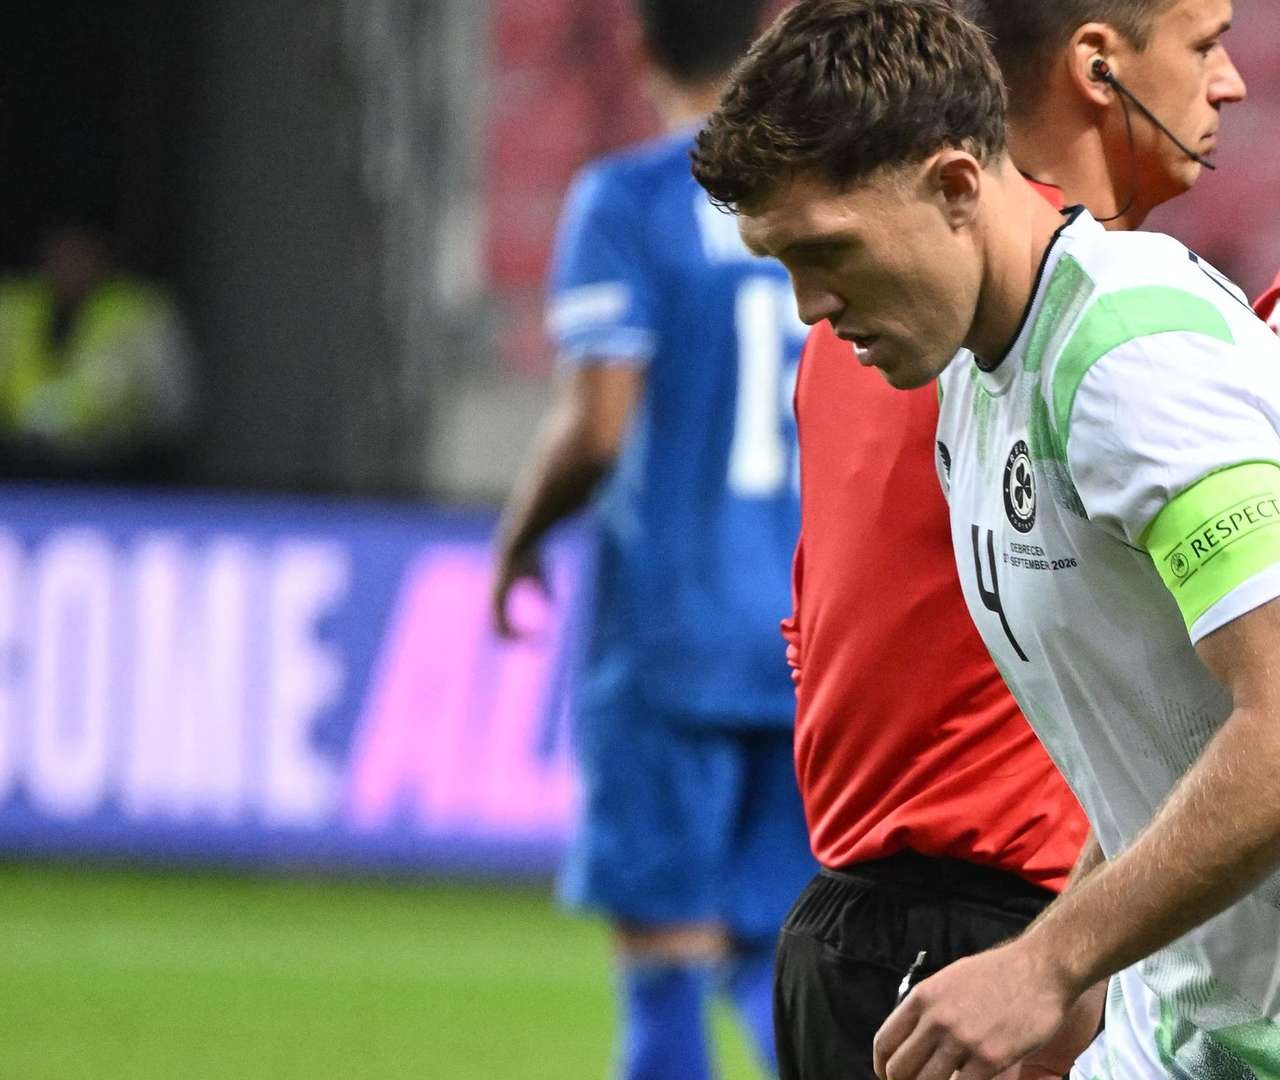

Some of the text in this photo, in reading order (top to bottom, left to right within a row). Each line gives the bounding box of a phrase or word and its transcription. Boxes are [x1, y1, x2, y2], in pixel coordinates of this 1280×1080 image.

[1190, 499, 1280, 558] RESPECT
[1010, 556, 1050, 570] SEPTEMBER
[1051, 557, 1077, 570] 2026
[971, 524, 1029, 663] 4
